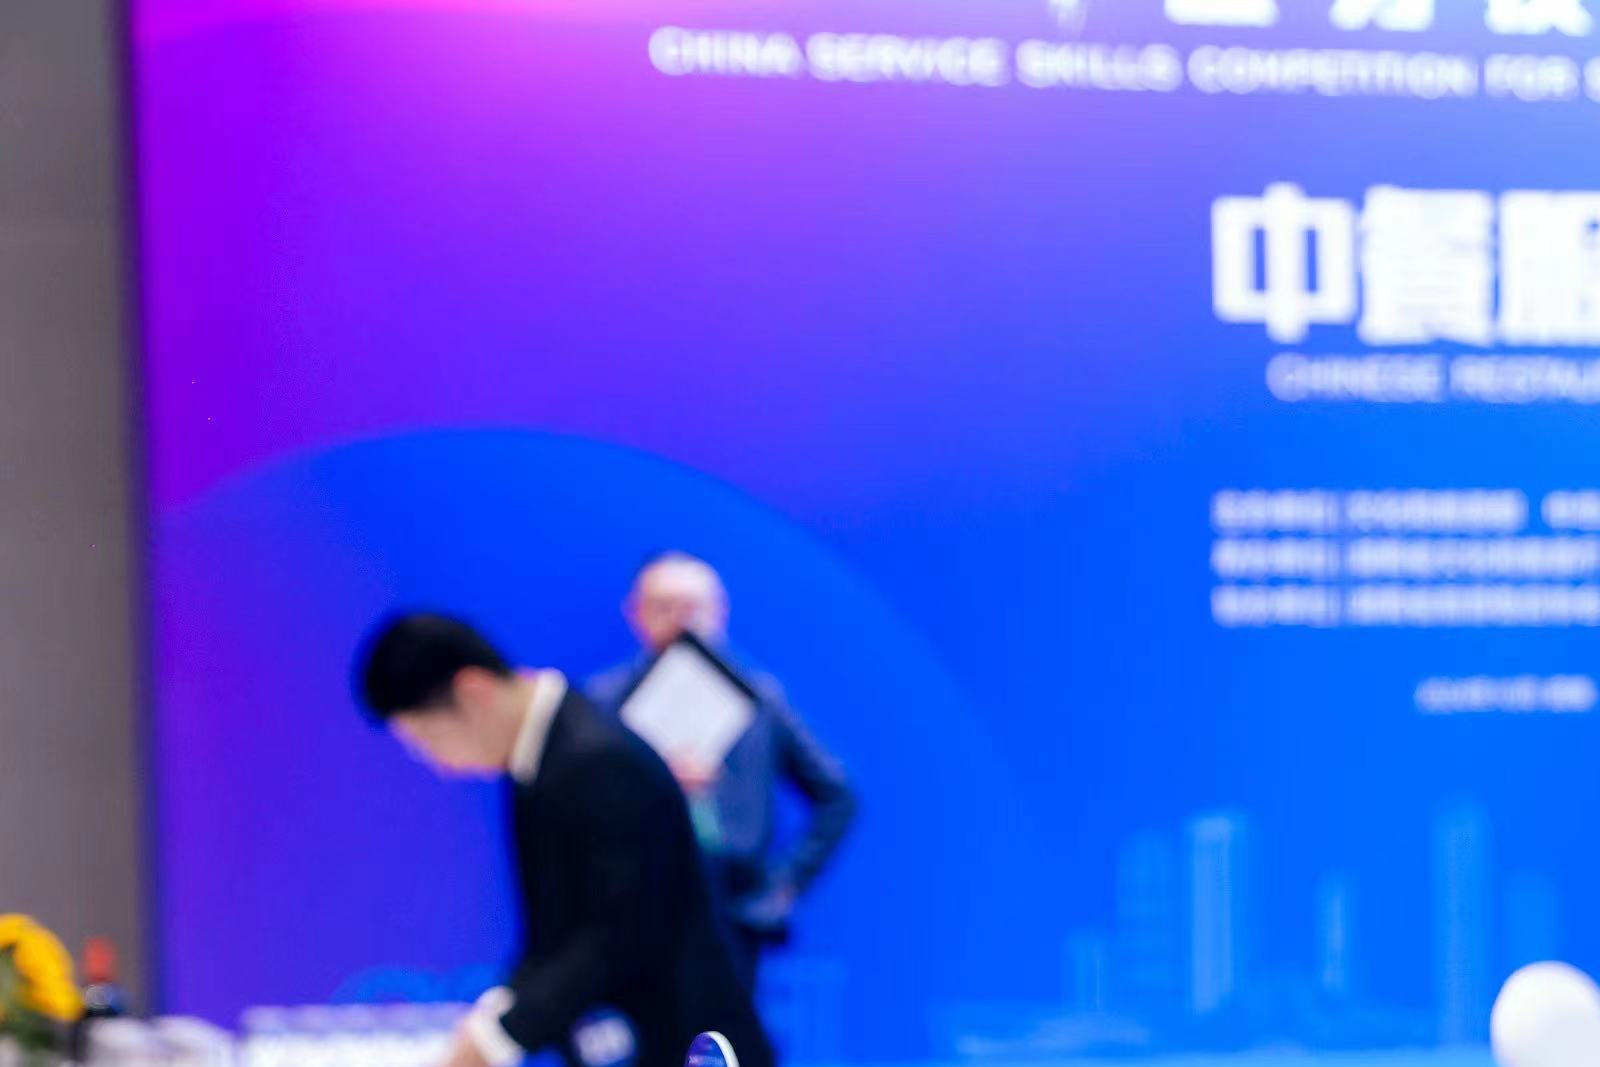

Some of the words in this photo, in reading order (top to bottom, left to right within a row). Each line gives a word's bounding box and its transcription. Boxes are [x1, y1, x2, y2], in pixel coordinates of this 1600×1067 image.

[649, 27, 798, 77] CHINA
[805, 32, 1005, 84] SERVICE
[1015, 39, 1182, 91] SKILLS
[1187, 45, 1478, 97] COMPETITION
[1484, 51, 1579, 101] FOR
[1266, 353, 1443, 402] CHINESE
